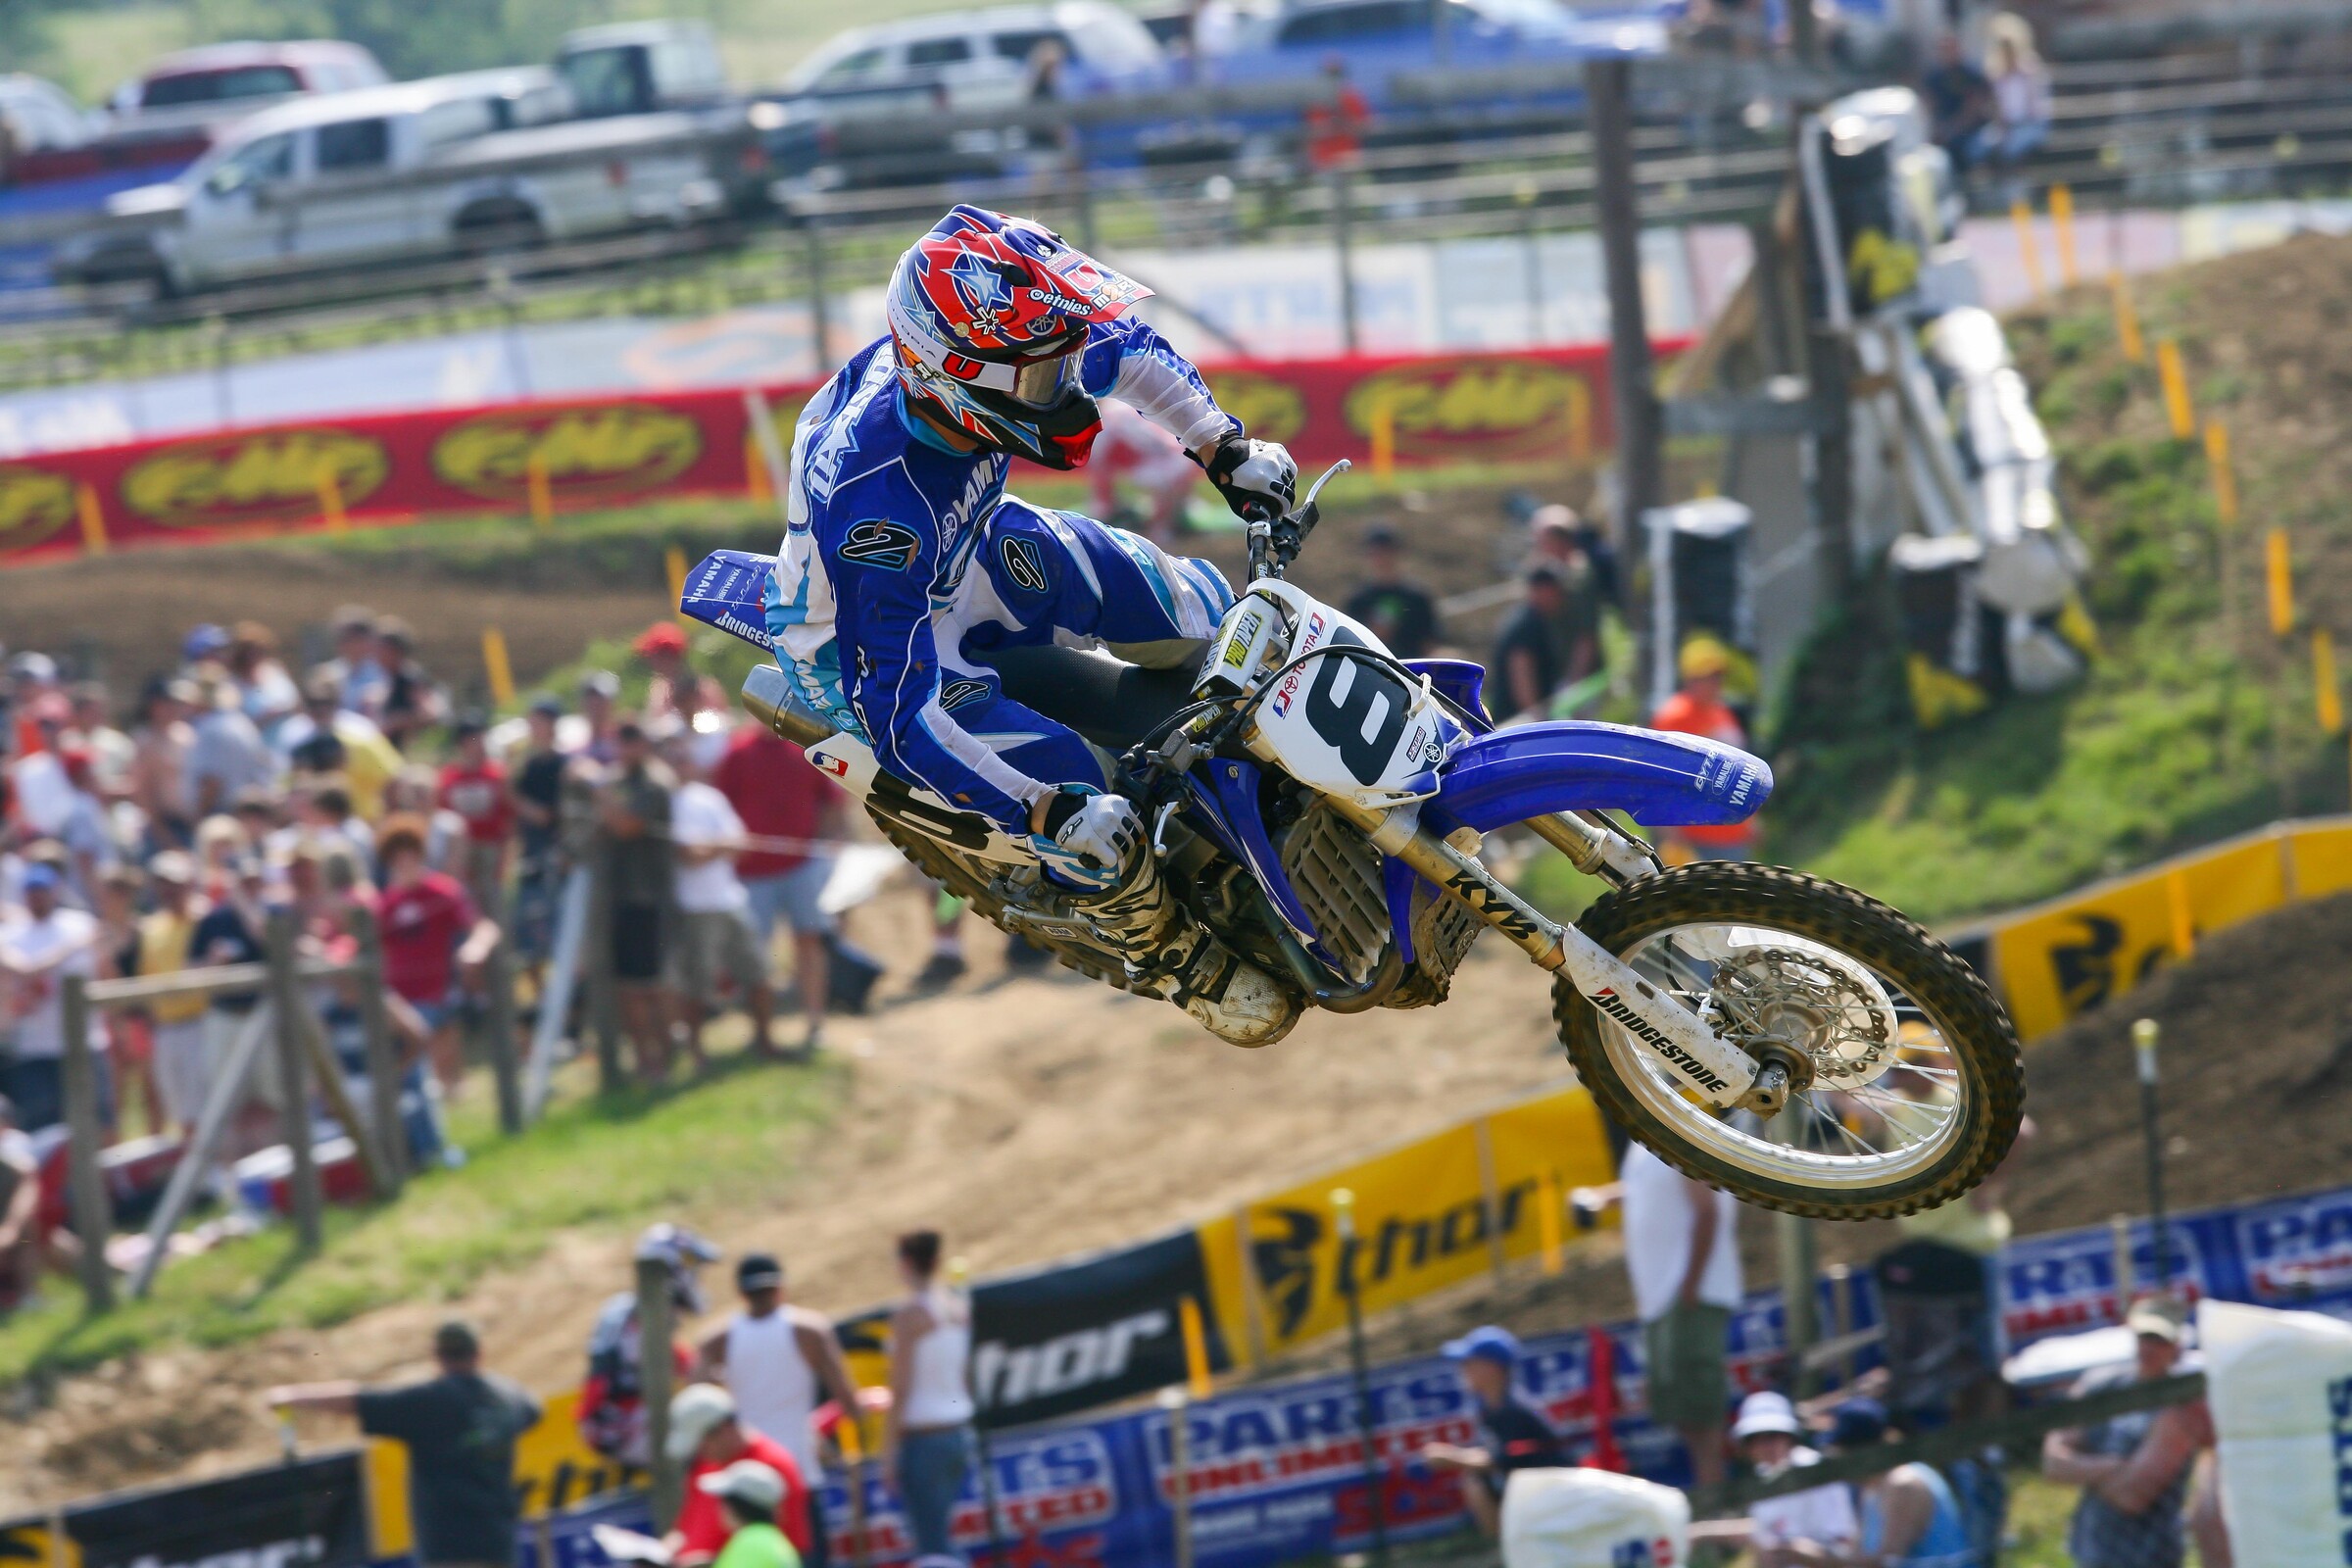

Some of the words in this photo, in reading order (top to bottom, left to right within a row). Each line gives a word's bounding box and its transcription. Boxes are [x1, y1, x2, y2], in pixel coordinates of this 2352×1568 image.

[1043, 292, 1091, 317] etnies
[687, 556, 727, 603] YAMAHA
[1293, 634, 1317, 675] TOOTA
[1305, 626, 1410, 786] 8
[1729, 763, 1760, 806] YAMAHA
[1445, 869, 1539, 940] KYB
[1587, 987, 1730, 1093] BRIDGESTONE
[975, 1307, 1169, 1405] hor
